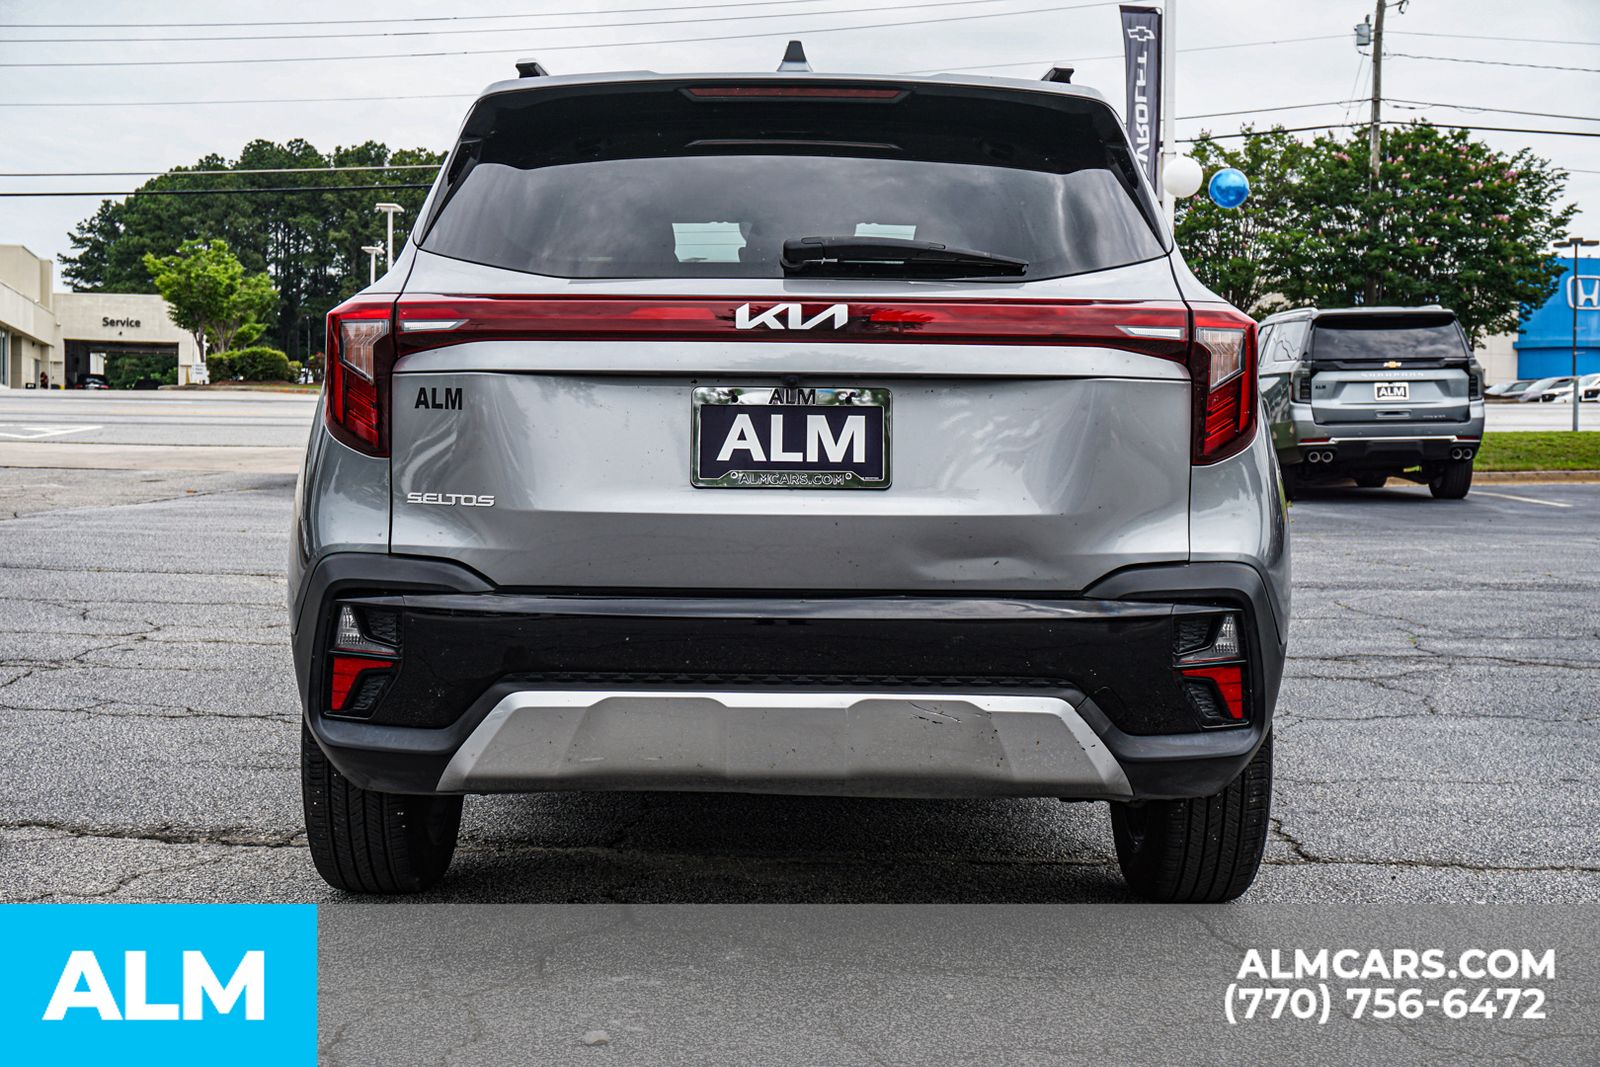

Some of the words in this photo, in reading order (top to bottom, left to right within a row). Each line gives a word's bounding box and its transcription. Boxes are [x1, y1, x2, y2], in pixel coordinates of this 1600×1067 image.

[102, 317, 141, 328] Service
[414, 387, 463, 411] ALM
[769, 388, 816, 405] ALM
[1379, 387, 1405, 397] ALM
[716, 413, 866, 463] ALM
[738, 472, 845, 485] ALMCARS.COM
[406, 492, 496, 507] SELTOS
